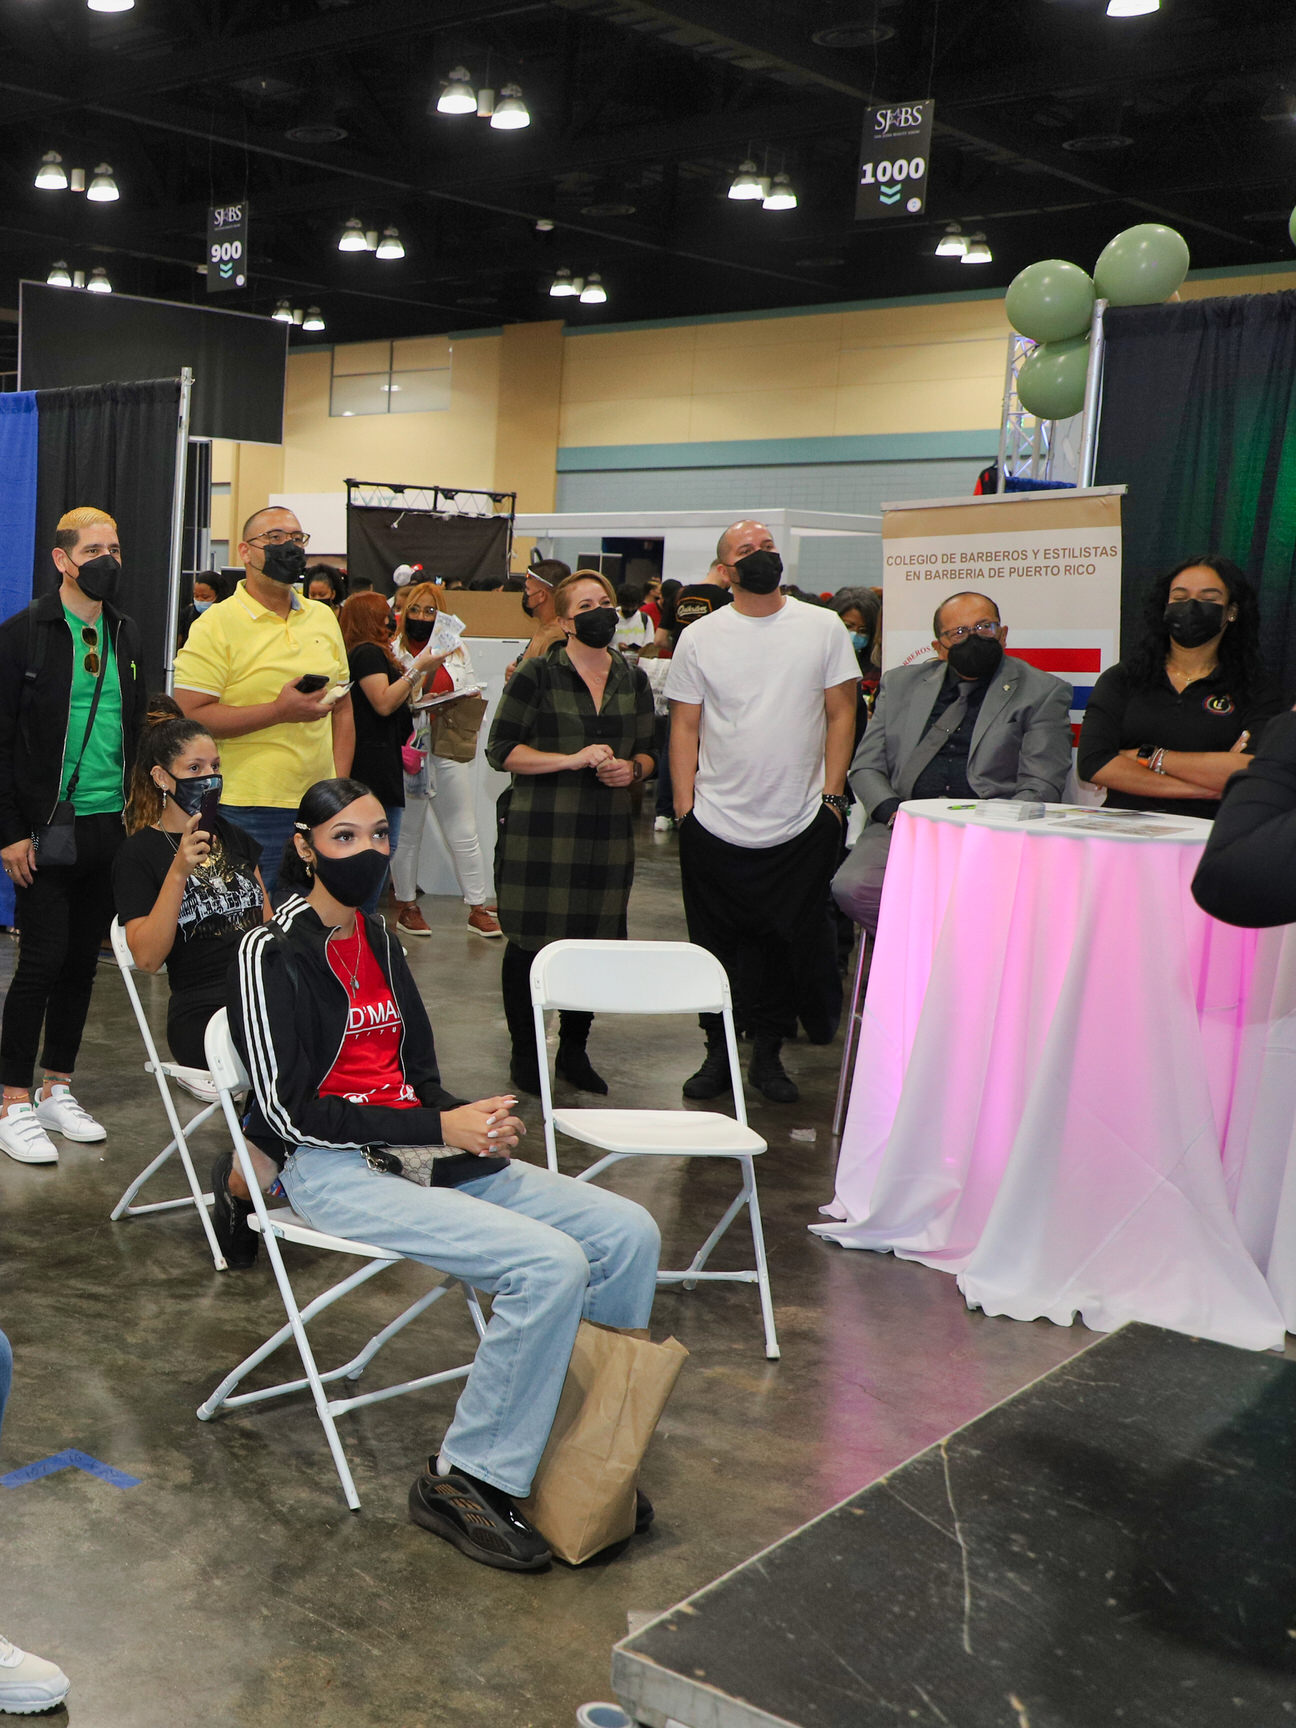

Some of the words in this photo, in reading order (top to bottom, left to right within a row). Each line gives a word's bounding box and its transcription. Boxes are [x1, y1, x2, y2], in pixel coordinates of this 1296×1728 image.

[860, 157, 925, 184] 1000
[211, 241, 242, 262] 900
[886, 554, 938, 567] COLEGIO
[941, 553, 957, 564] DE
[960, 549, 1028, 563] BARBEROS
[1032, 549, 1041, 560] Y
[1043, 545, 1118, 559] ESTILISTAS
[905, 570, 921, 581] EN
[924, 568, 985, 581] BARBERIA
[988, 567, 1005, 579] DE
[1009, 565, 1061, 578] PUERTO
[1064, 564, 1096, 576] RICO
